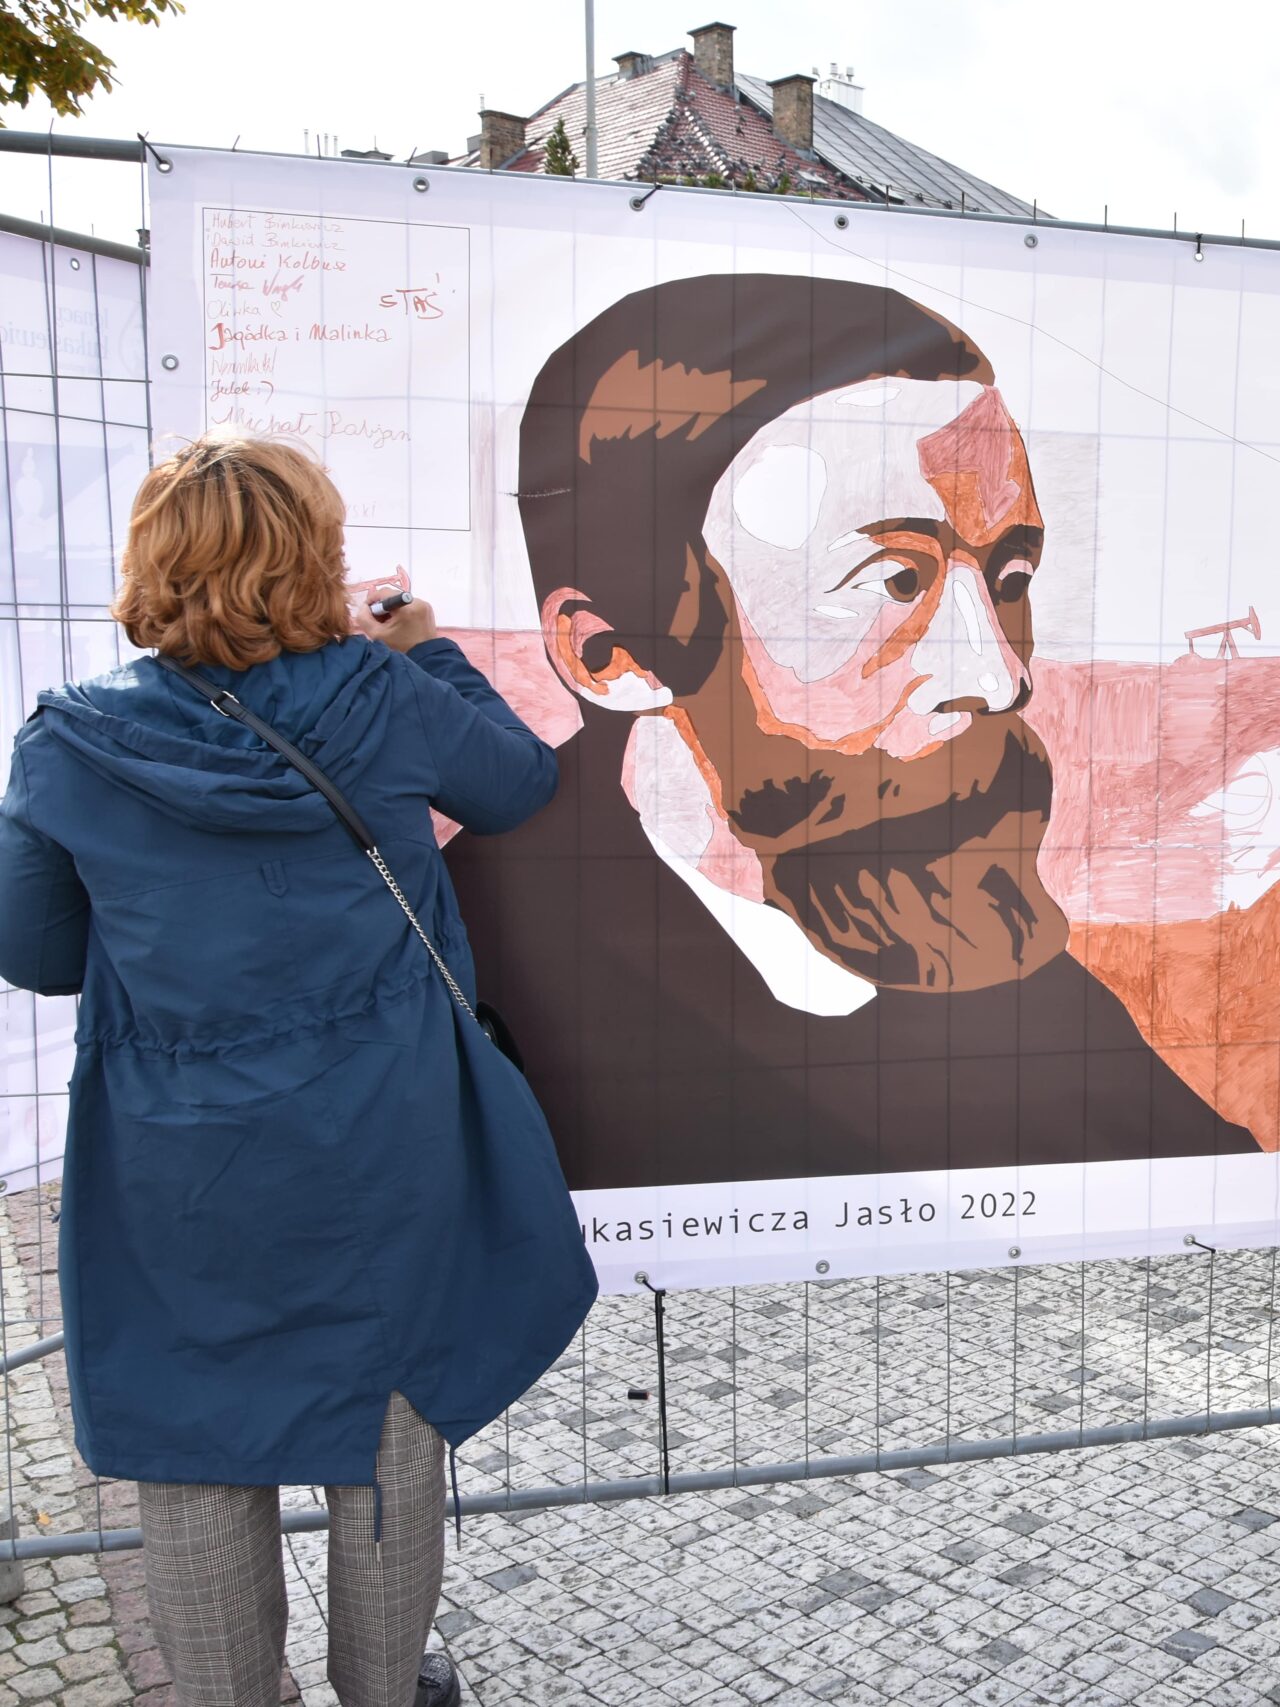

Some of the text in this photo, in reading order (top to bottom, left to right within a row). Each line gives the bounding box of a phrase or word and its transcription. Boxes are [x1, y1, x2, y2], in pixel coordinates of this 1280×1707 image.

[309, 323, 392, 342] Malinka
[835, 1198, 936, 1229] Jasło
[960, 1190, 1038, 1221] 2022
